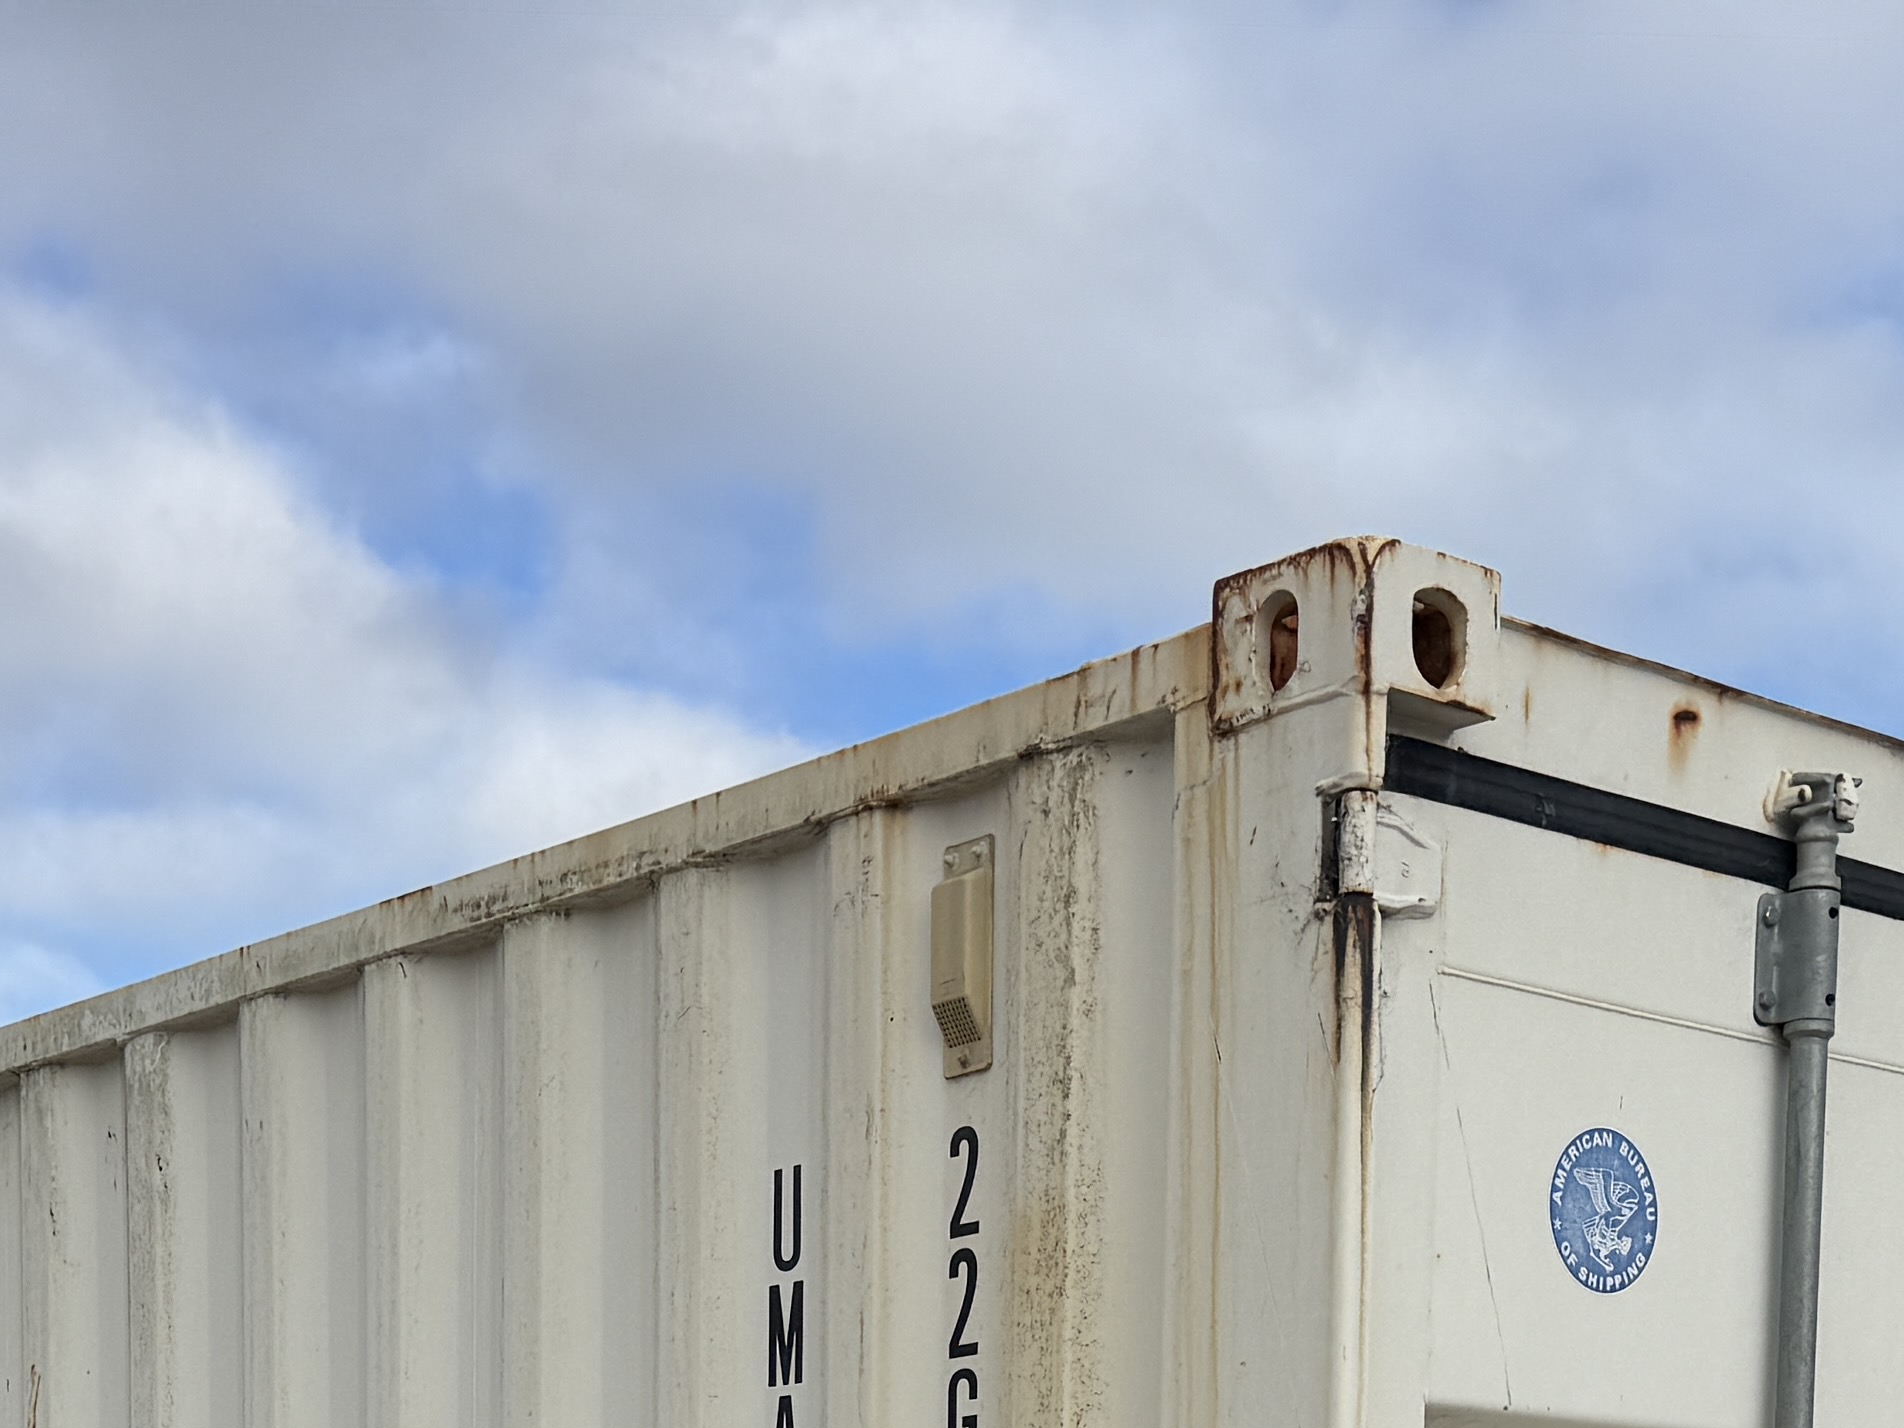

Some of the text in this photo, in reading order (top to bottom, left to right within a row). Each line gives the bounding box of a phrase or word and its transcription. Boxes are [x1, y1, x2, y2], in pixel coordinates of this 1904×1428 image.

[1551, 1131, 1657, 1222] AMERICAN BUREAU
[1558, 1240, 1646, 1291] OF SHIPPING
